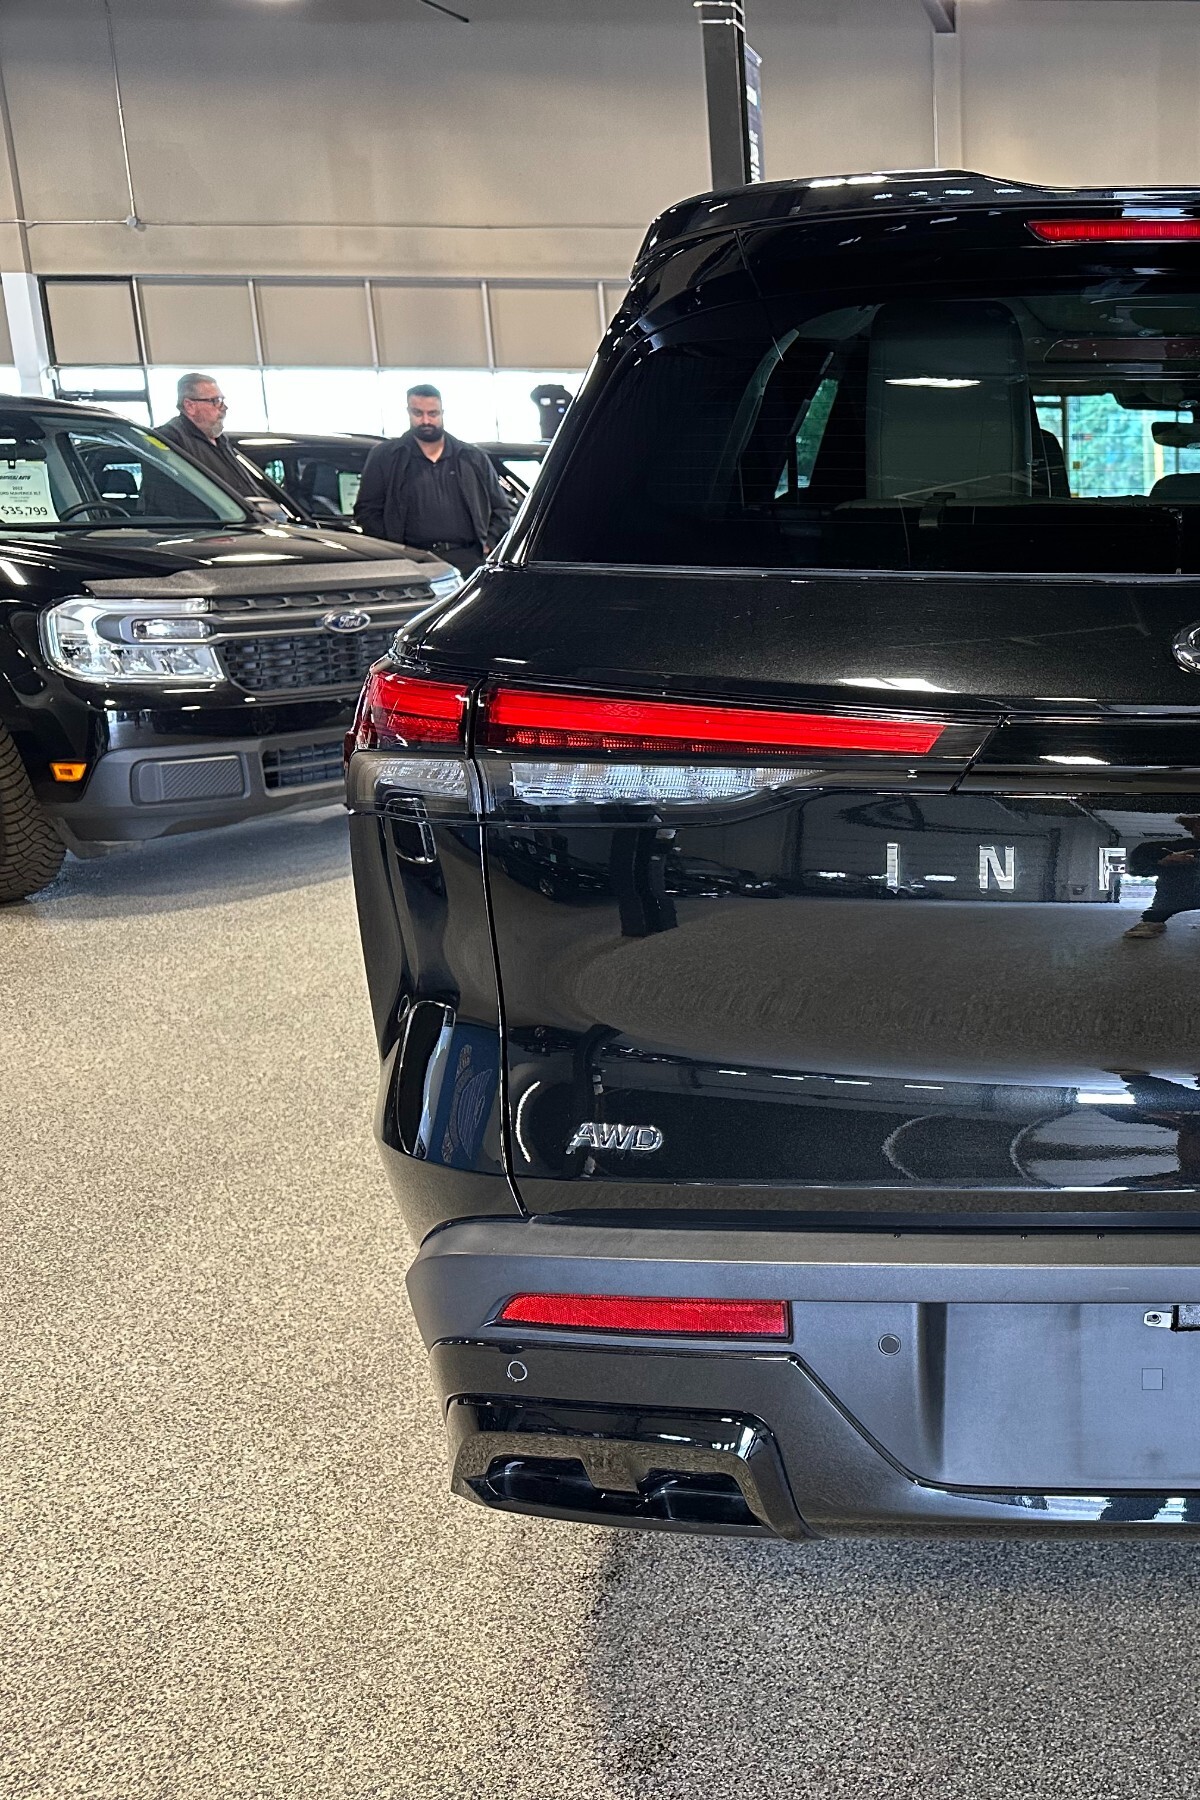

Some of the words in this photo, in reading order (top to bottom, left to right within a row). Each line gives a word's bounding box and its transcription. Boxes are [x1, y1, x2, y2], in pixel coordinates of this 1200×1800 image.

[1, 505, 48, 516] $35,799
[339, 615, 361, 628] Ford
[570, 1122, 663, 1151] AWD
